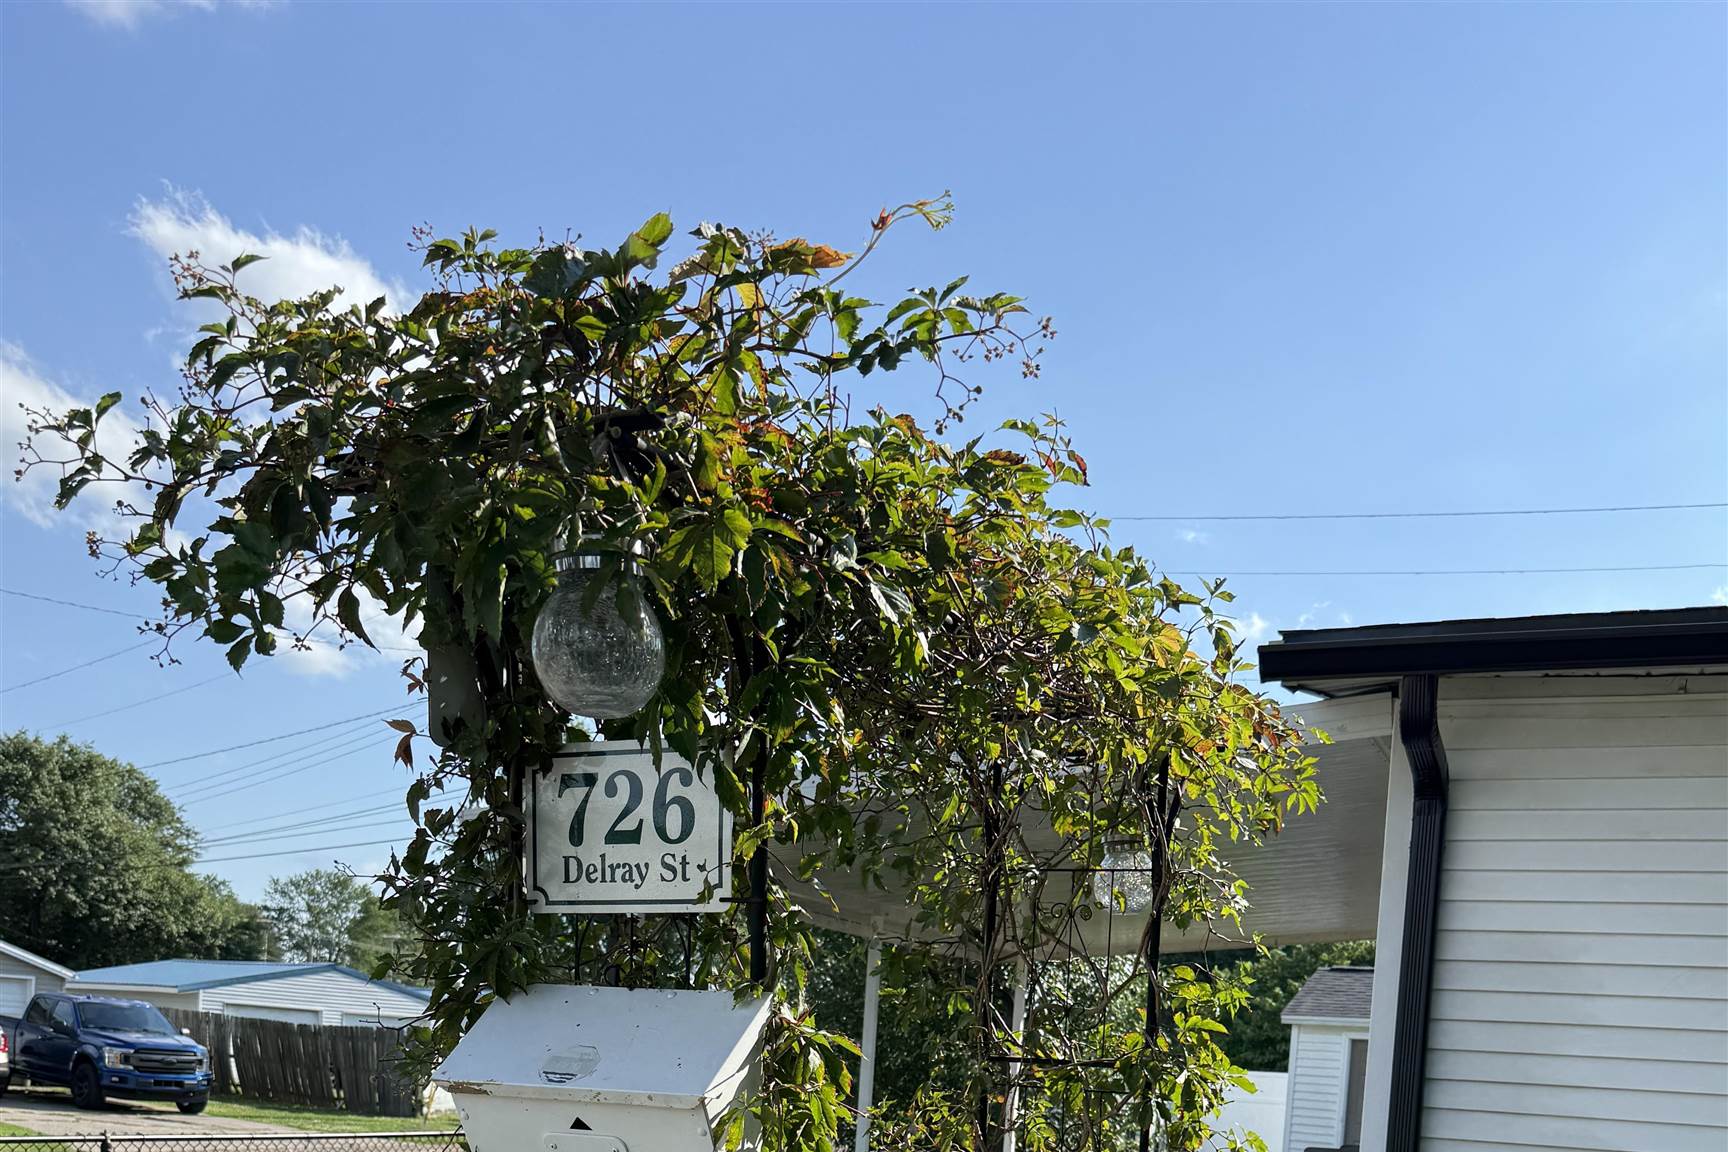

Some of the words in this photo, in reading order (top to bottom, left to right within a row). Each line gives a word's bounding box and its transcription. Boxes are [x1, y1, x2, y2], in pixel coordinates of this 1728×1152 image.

[558, 767, 695, 847] 726
[562, 853, 649, 889] Delray
[660, 852, 691, 882] St
